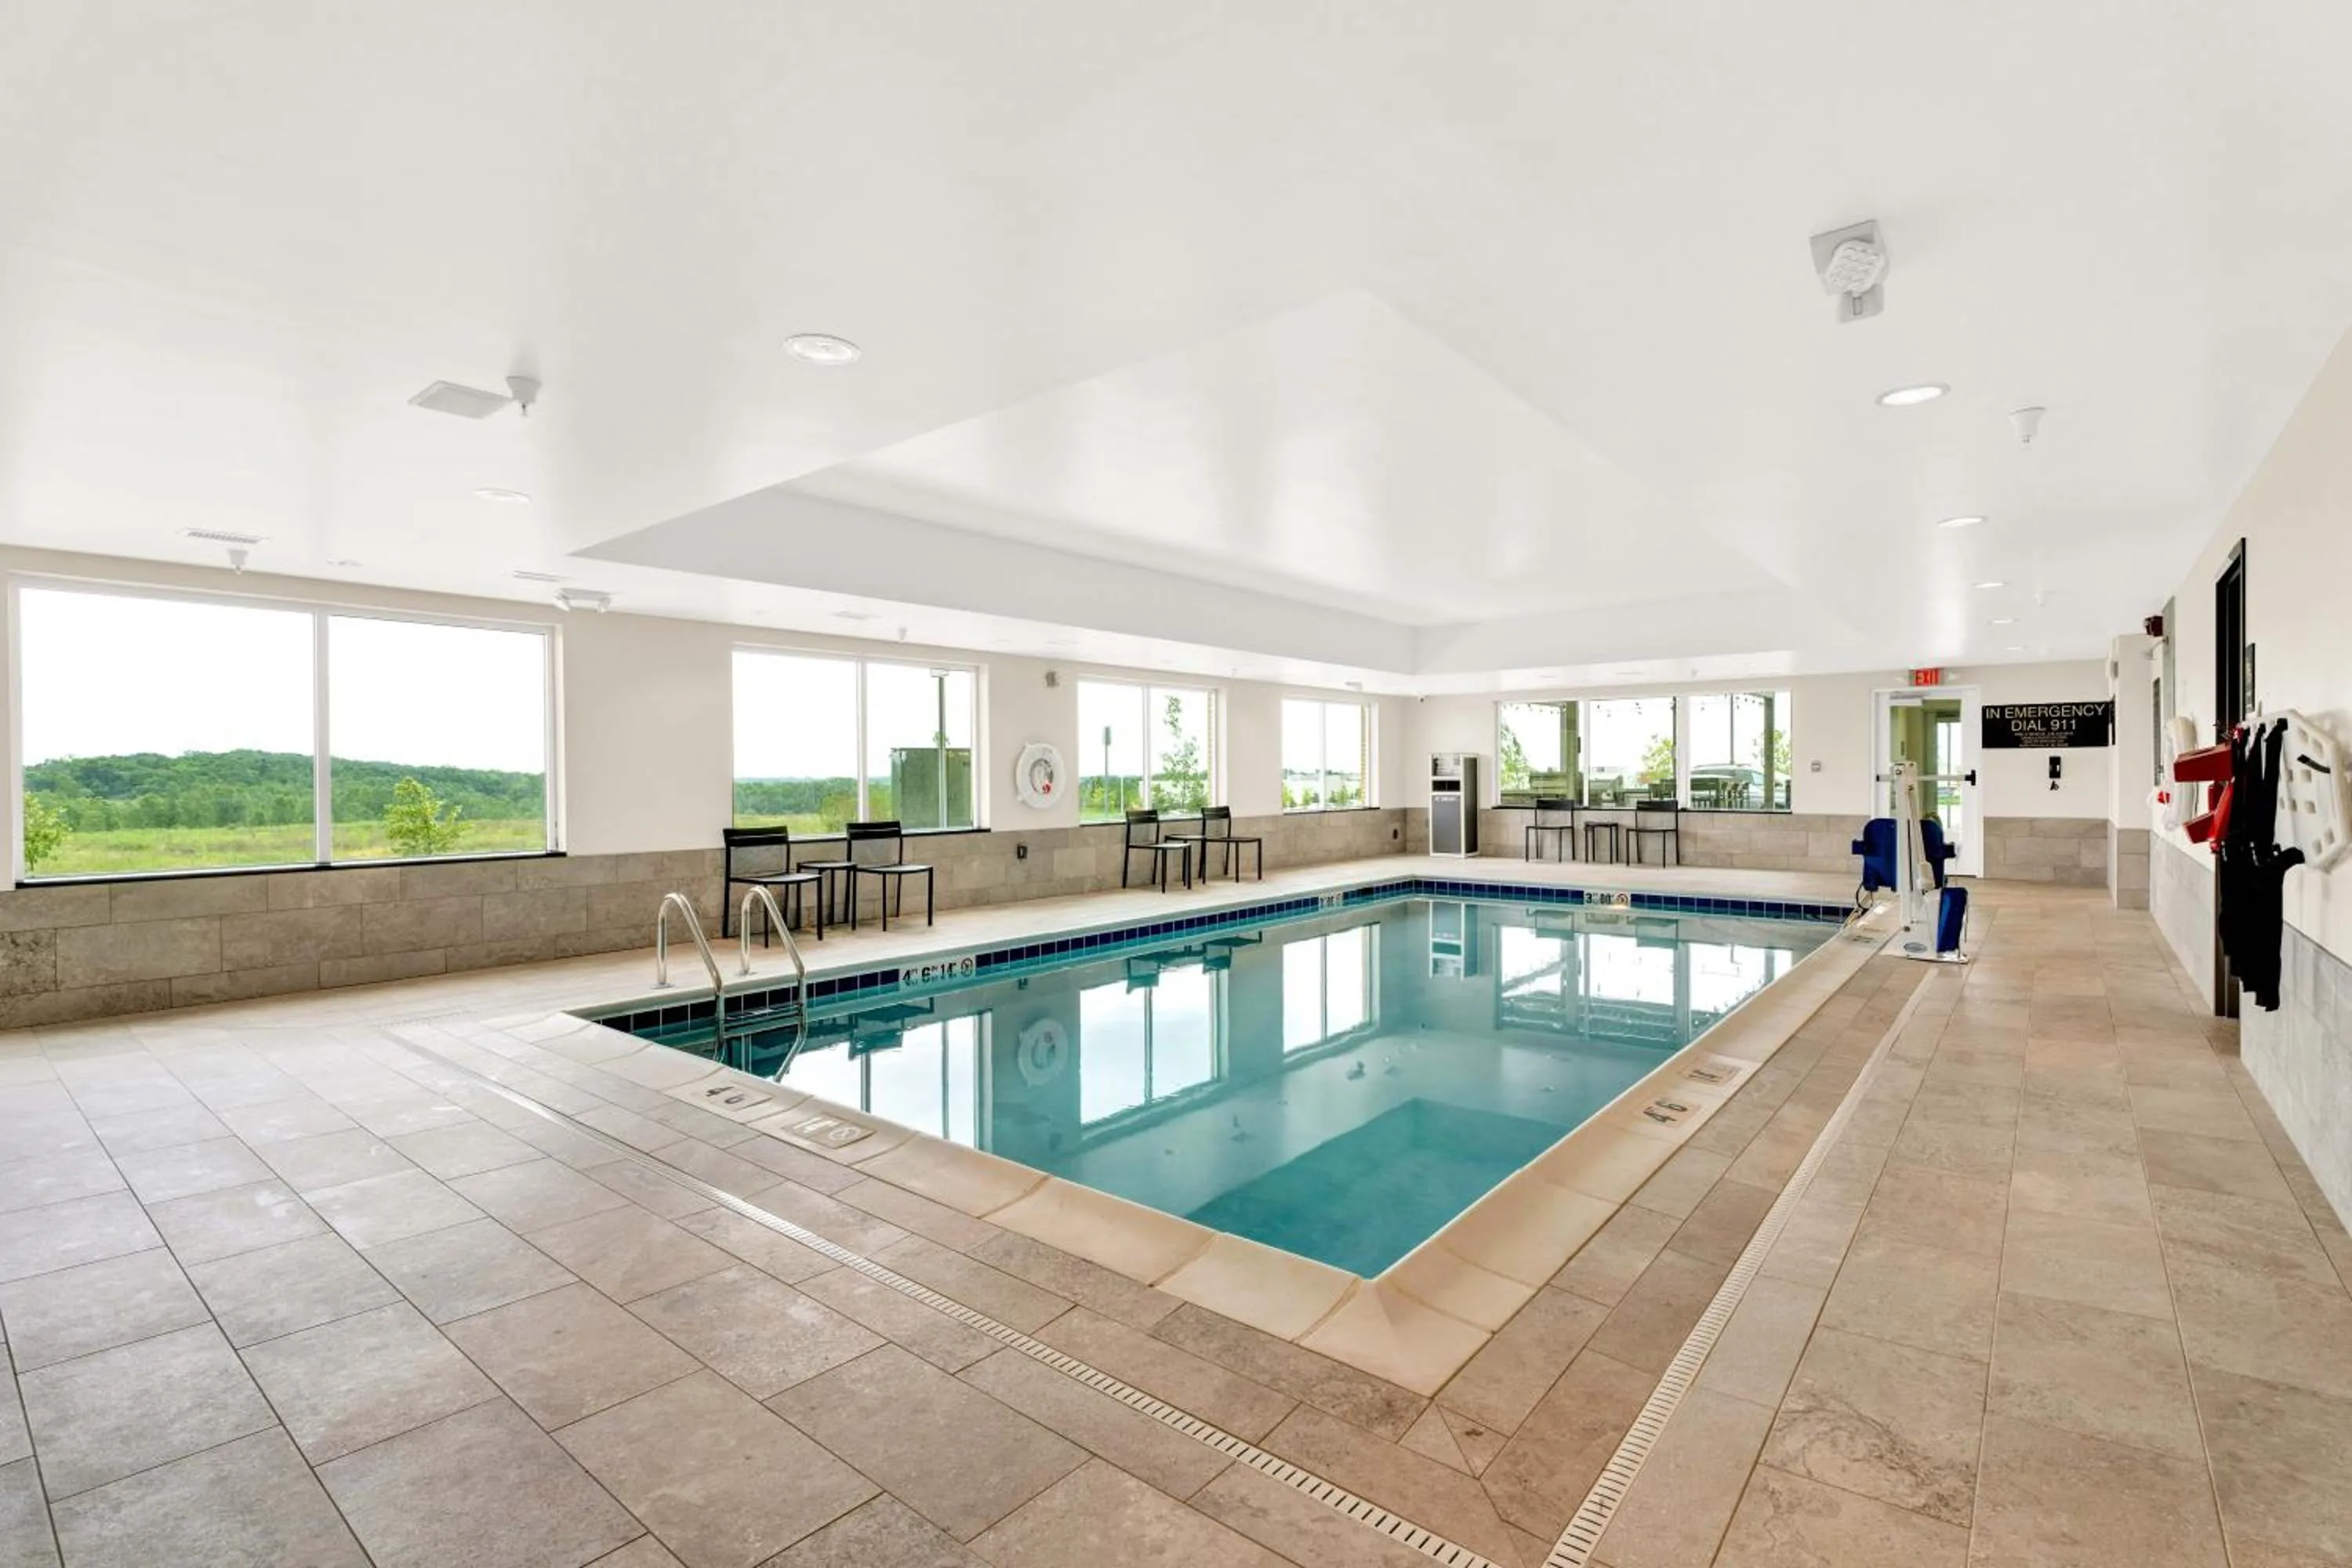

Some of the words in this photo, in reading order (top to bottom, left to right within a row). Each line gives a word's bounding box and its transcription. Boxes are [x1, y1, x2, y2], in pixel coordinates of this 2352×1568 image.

[1915, 668, 1940, 687] EXIT
[1986, 707, 2000, 719] IN
[2005, 703, 2105, 719] EMERGENCY
[2011, 719, 2047, 731] DIAL
[2050, 719, 2076, 731] 911
